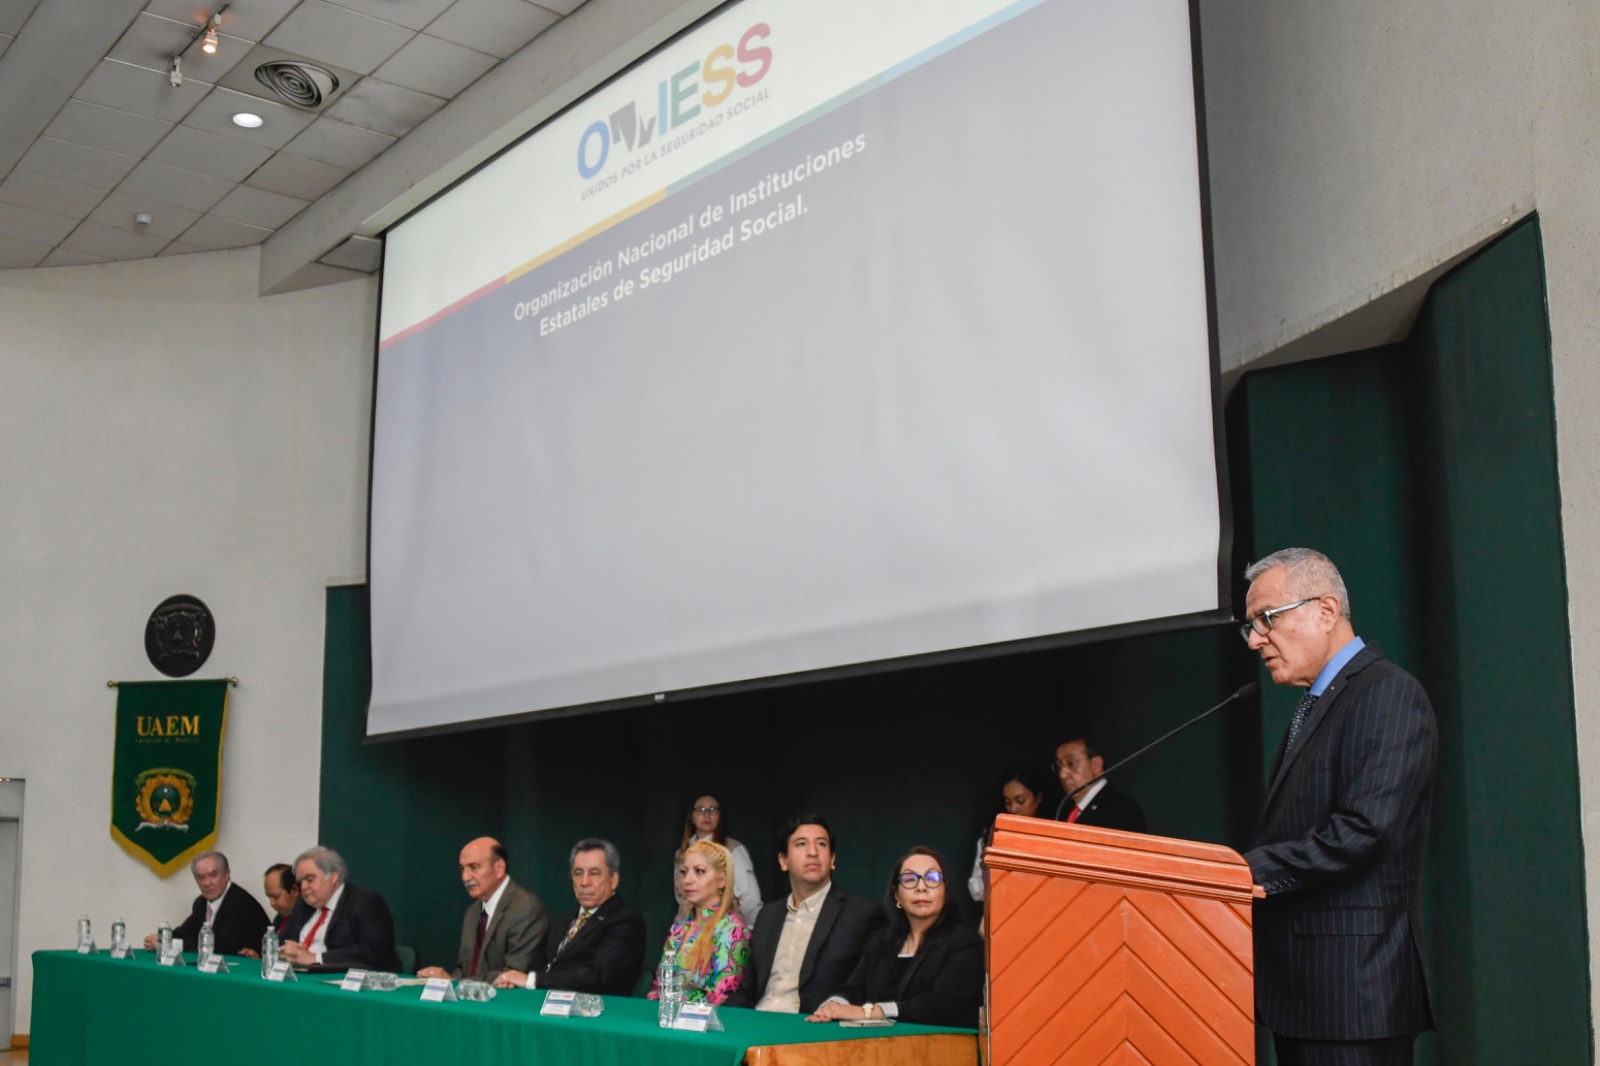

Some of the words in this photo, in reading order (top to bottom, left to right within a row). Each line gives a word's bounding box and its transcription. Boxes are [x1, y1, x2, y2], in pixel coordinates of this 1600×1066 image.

[580, 171, 618, 201] UNIDOS
[621, 159, 641, 179] POR
[644, 152, 658, 167] LA
[660, 113, 723, 157] SEGURIDAD
[726, 88, 771, 120] SOCIAL
[513, 260, 613, 321] Organización
[617, 213, 694, 270] Nacional
[699, 205, 723, 229] de
[730, 134, 866, 215] Instituciones
[540, 291, 608, 337] Estatales
[613, 279, 634, 301] de
[639, 226, 734, 289] Seguridad
[740, 193, 808, 242] Social.
[136, 715, 200, 736] UAEM
